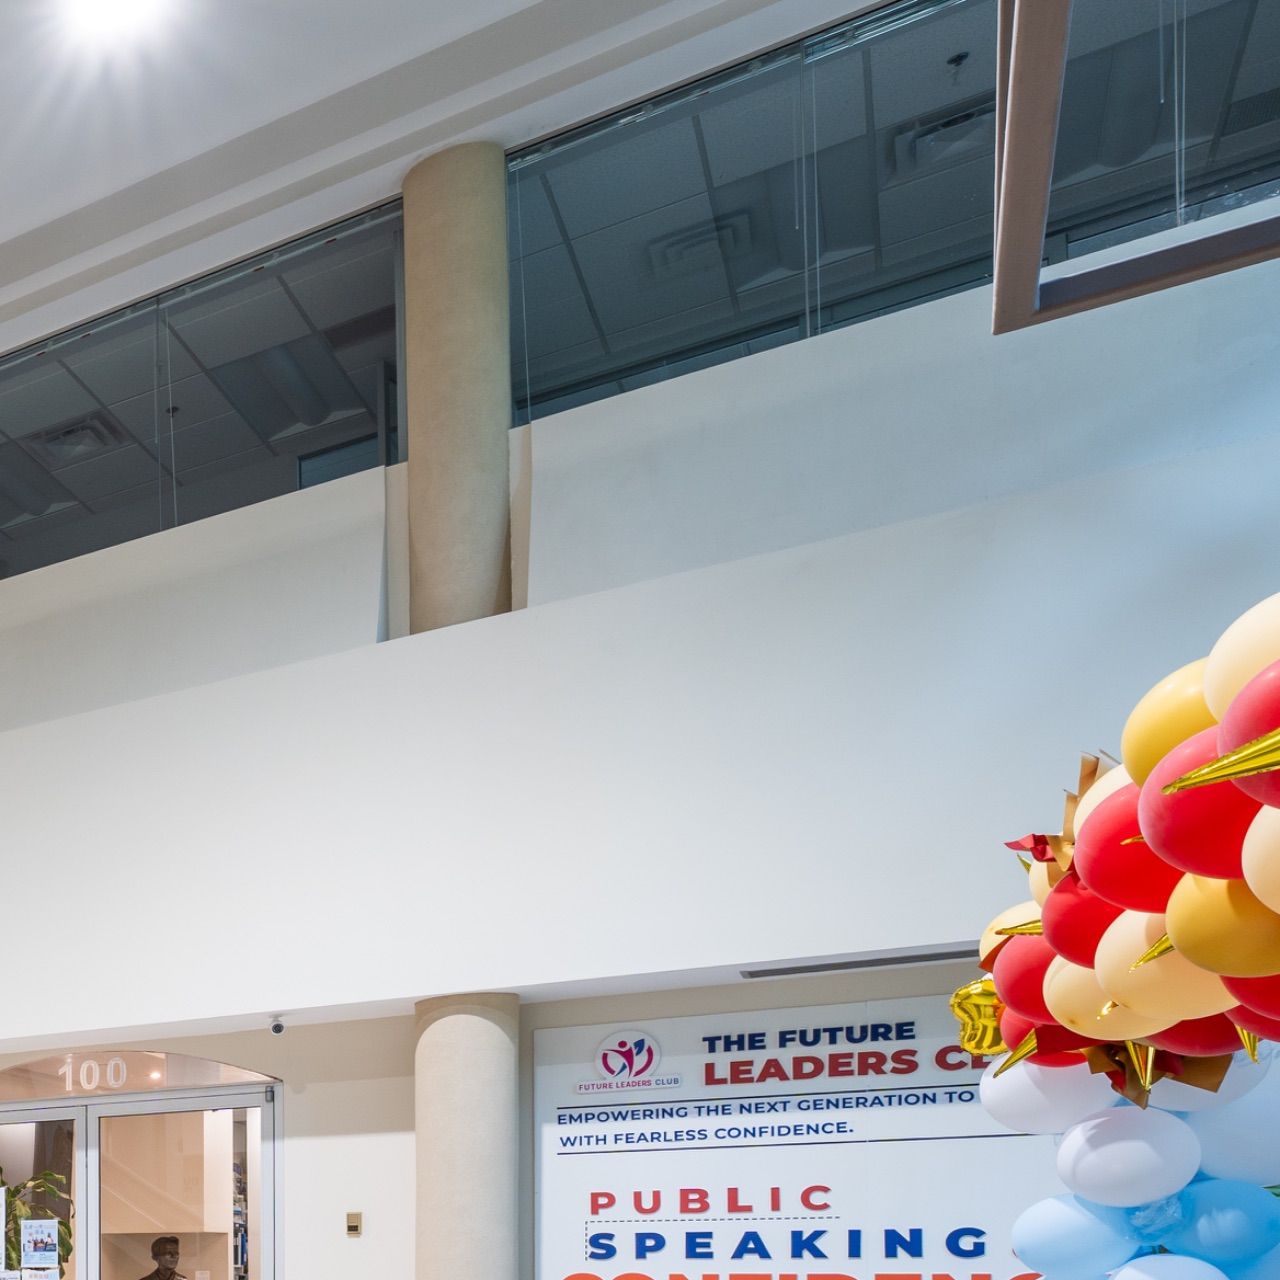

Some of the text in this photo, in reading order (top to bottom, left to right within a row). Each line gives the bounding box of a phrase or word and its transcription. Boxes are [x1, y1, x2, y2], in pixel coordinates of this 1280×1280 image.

[702, 1021, 916, 1053] THE FUTURE
[57, 1057, 127, 1092] 100
[704, 1049, 919, 1086] LEADERS
[578, 1077, 680, 1092] FUTURE LEADERS CLUB
[557, 1090, 975, 1125] EMPOWERING THE NEXT GENERATION TO
[560, 1121, 854, 1147] WITH FEARLESS CONFIDENCE.
[590, 1184, 833, 1216] PUBLIC
[587, 1227, 987, 1261] SPEAKING
